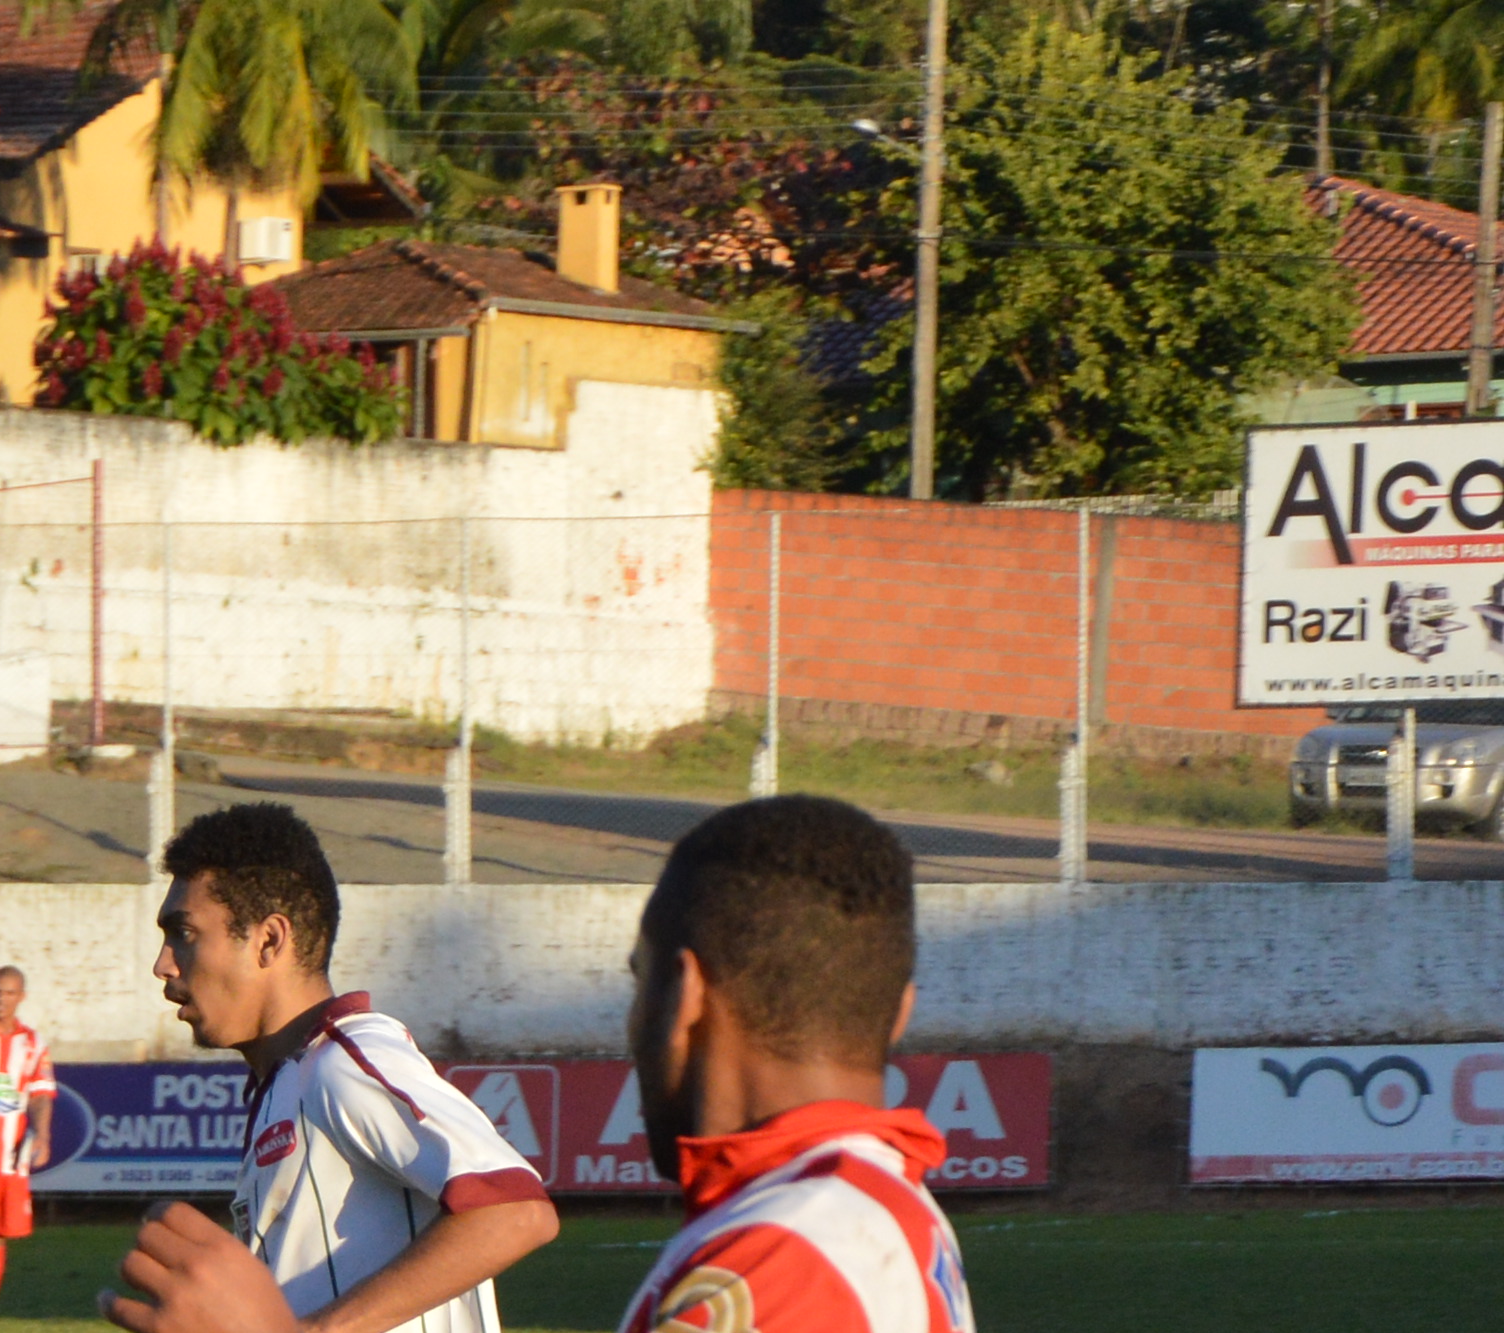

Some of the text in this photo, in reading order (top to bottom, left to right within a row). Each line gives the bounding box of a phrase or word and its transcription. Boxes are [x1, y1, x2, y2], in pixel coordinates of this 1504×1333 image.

[1263, 598, 1368, 644] Razi
[154, 1073, 250, 1109] POST
[96, 1114, 194, 1148] SANTA
